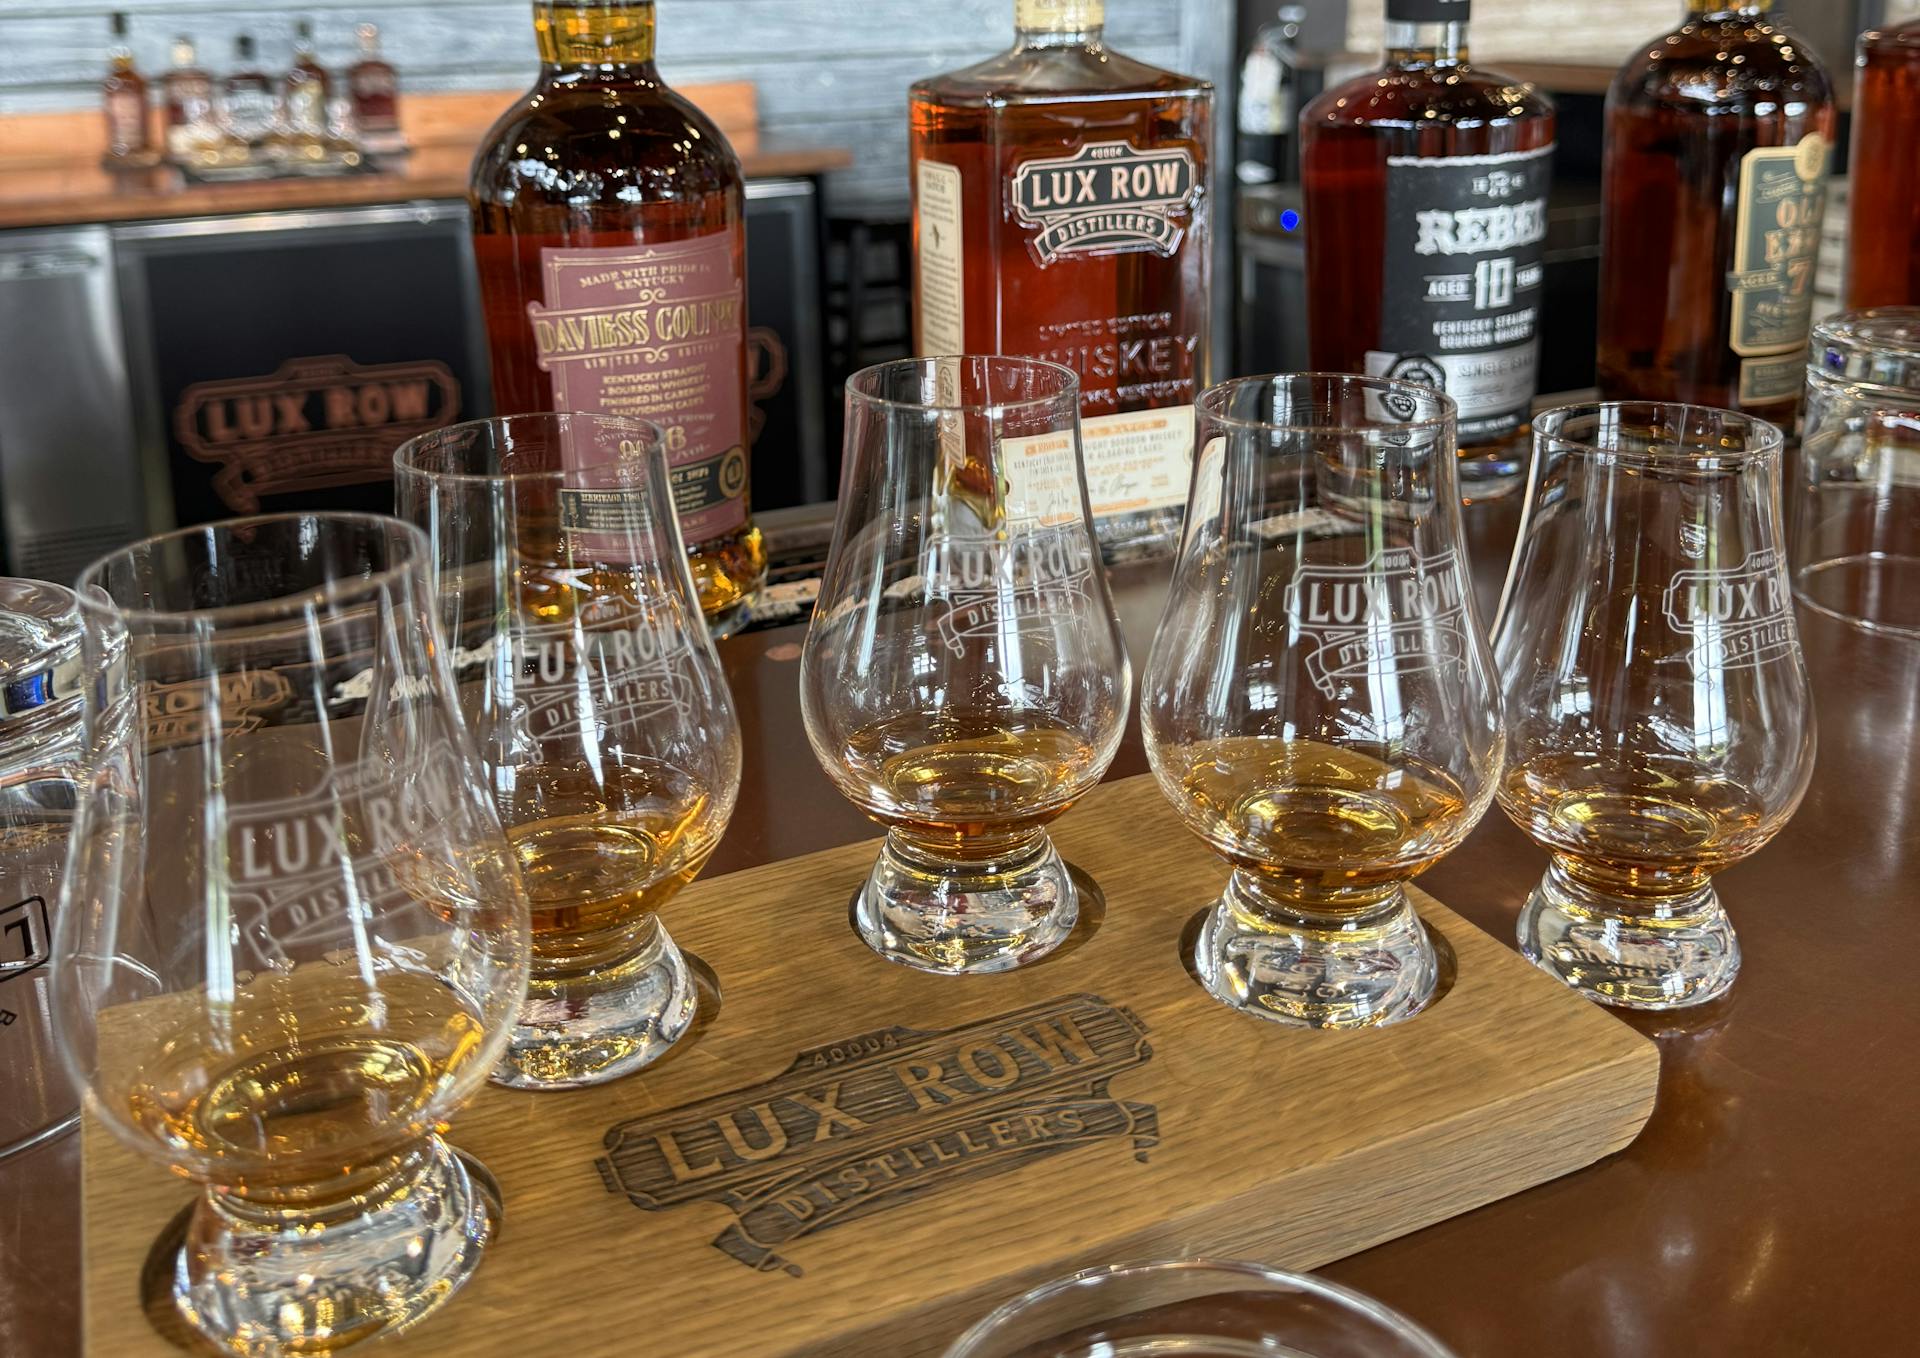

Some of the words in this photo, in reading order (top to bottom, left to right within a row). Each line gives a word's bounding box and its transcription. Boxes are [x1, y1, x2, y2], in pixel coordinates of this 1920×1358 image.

[1031, 167, 1098, 208] LUX
[1110, 161, 1181, 200] ROW
[1056, 213, 1157, 243] DISTILLERS
[1415, 198, 1547, 256] REBEL
[578, 271, 619, 289] MADE
[621, 264, 658, 279] WITH
[613, 274, 686, 292] KENTUCKY
[1474, 256, 1516, 310] 10
[535, 310, 651, 354] DAVIESS
[1432, 317, 1494, 336] KENTUCKY
[602, 370, 660, 385] KENTUCKY
[203, 393, 311, 443] LUX
[939, 549, 1015, 589] LUX
[1027, 536, 1083, 585] ROW
[1308, 582, 1386, 624] LUX
[1401, 566, 1460, 619] ROW
[1687, 582, 1757, 622] LUX
[512, 634, 600, 686] LUX
[613, 609, 680, 671] ROW
[241, 813, 347, 879] LUX
[654, 1082, 872, 1185] LUX
[888, 1014, 1101, 1112] ROW
[776, 1109, 1088, 1221] DISTILLERS
